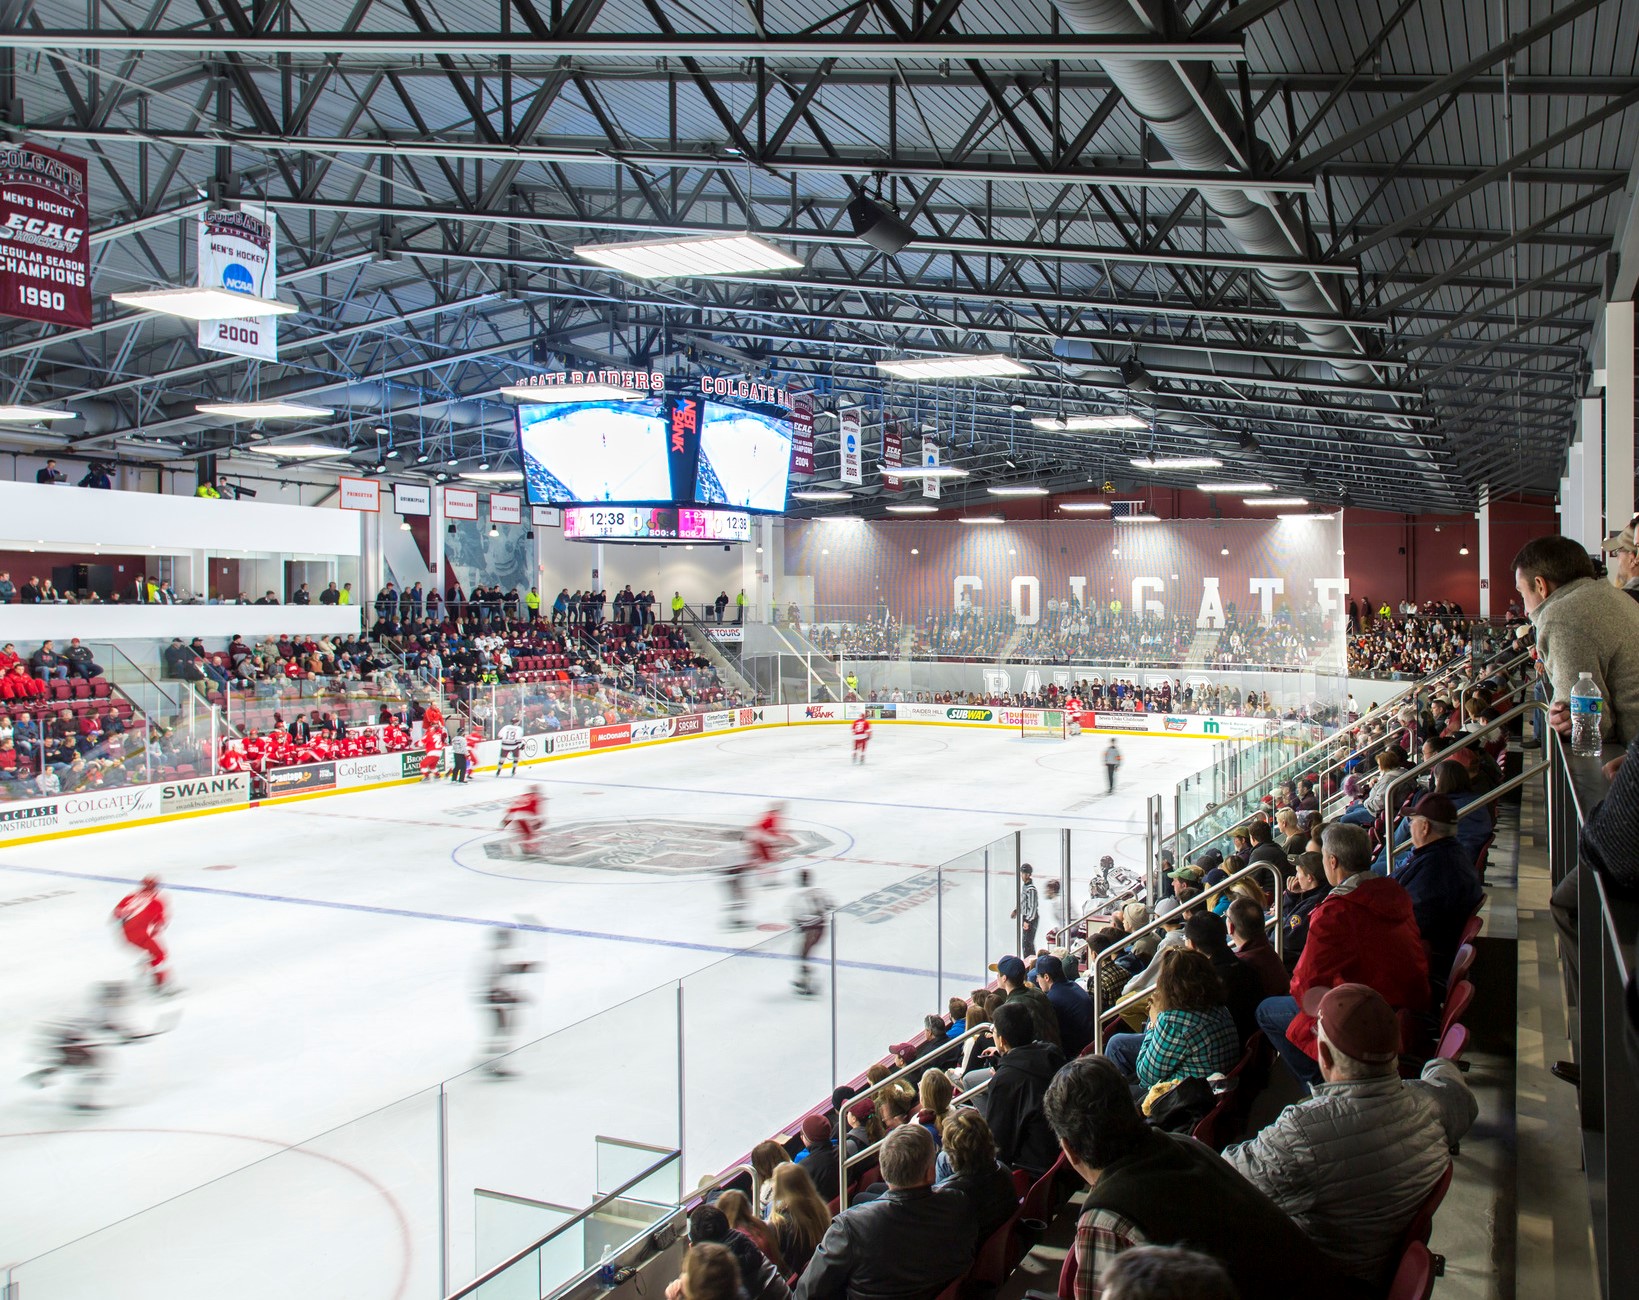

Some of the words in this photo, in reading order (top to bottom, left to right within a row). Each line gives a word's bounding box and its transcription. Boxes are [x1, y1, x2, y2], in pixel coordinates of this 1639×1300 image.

[0, 150, 82, 190] COLGATE
[9, 173, 70, 195] RAIDERS
[3, 190, 34, 208] MEN'S
[37, 198, 75, 219] HOCKEY
[5, 212, 83, 244] ECAC
[215, 227, 262, 246] RAIDERS
[14, 230, 78, 254] HOCKEY
[211, 242, 233, 256] MEN'S
[237, 249, 265, 264] HOCKEY
[0, 256, 86, 287] CHAMPIONS
[46, 254, 85, 273] SEASON
[226, 277, 253, 291] NCAA
[19, 285, 65, 311] 1990
[219, 323, 259, 345] 2000
[571, 371, 664, 390] RAIDERS
[701, 375, 775, 403] COLGATE
[684, 399, 696, 434] NBT
[672, 407, 684, 454] BANK
[794, 422, 812, 433] ECAC
[795, 456, 809, 468] 2004
[590, 512, 625, 526] 12:38
[810, 711, 833, 719] BANK
[949, 709, 990, 720] SUBWAY
[1009, 711, 1040, 719] DUNKIN'
[598, 730, 630, 741] McDonald's
[678, 720, 699, 732] SASAKI
[556, 731, 589, 744] COLGATE
[557, 740, 588, 748] BOOKSTORE
[339, 763, 377, 779] Colgate
[364, 773, 381, 781] Dining
[163, 777, 245, 799] SWANK.
[65, 794, 134, 814] COLGATE
[69, 812, 128, 825] www.colgateinn.com
[1115, 873, 1132, 886] 5
